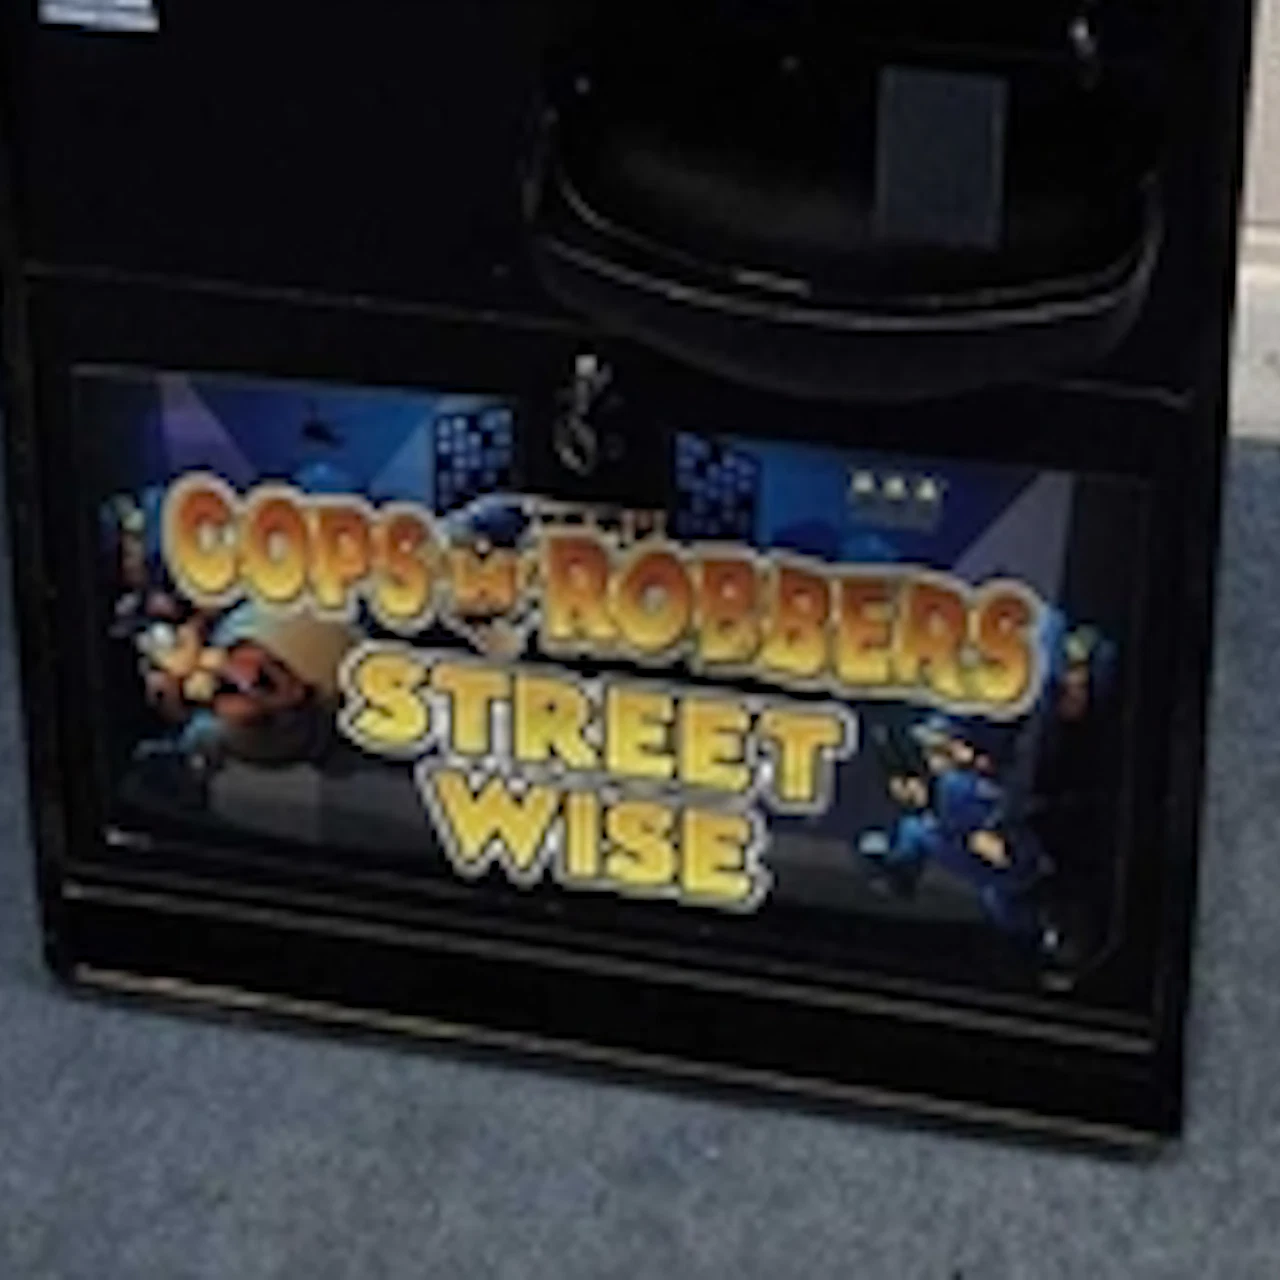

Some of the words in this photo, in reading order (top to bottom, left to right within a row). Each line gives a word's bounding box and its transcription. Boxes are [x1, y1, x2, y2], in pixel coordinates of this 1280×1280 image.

[165, 473, 437, 623] COPS
[540, 529, 1045, 718] ROBBERS
[339, 641, 855, 810] STREET
[418, 757, 772, 910] WISE
